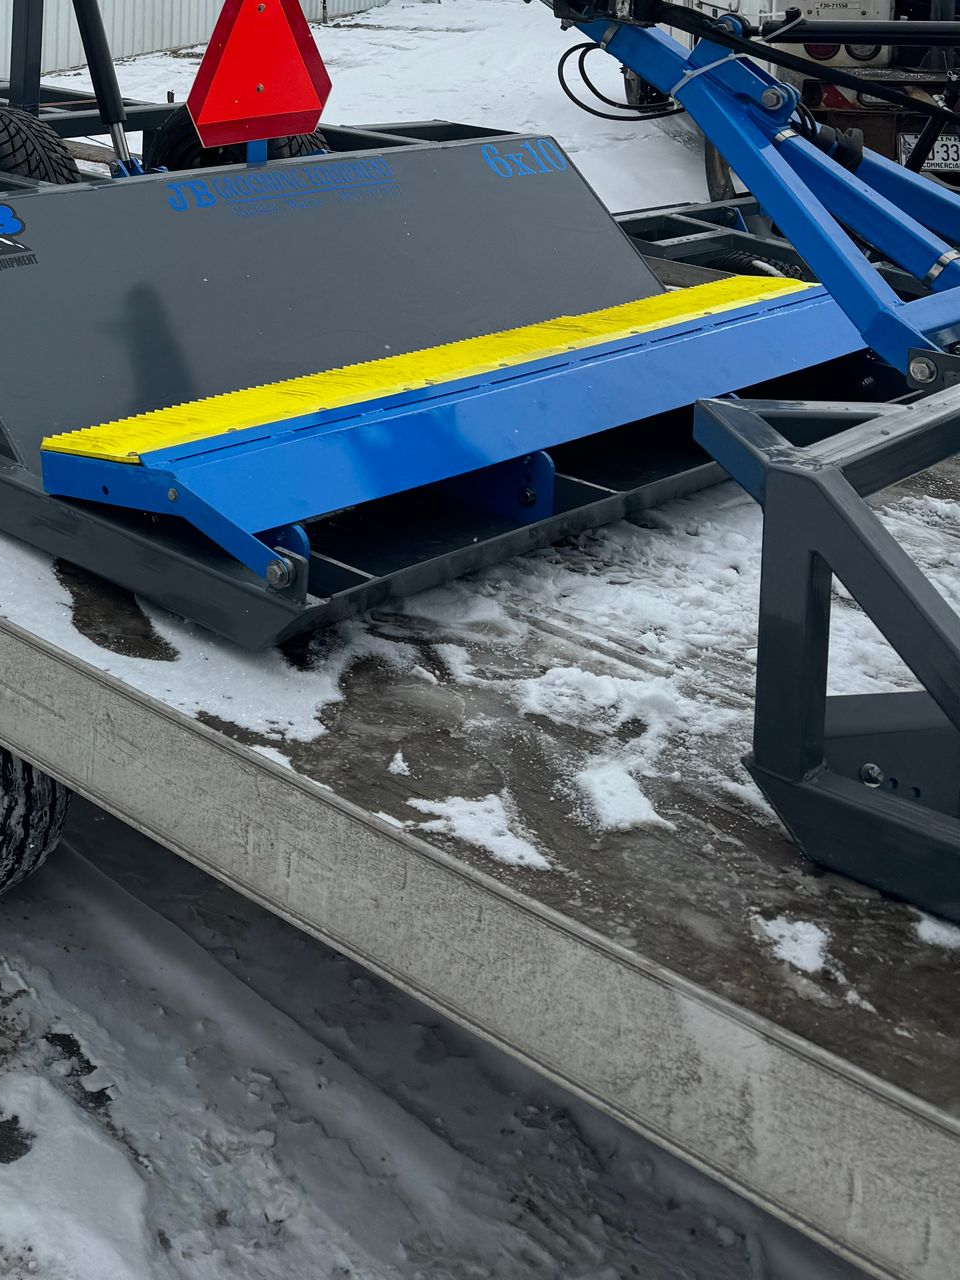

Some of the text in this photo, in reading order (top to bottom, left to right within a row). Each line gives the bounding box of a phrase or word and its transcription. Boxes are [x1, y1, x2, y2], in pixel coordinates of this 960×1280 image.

[480, 138, 568, 178] 6x10
[163, 179, 218, 213] JB
[212, 167, 303, 200] GROOMING
[304, 156, 394, 188] EQUIPMENT
